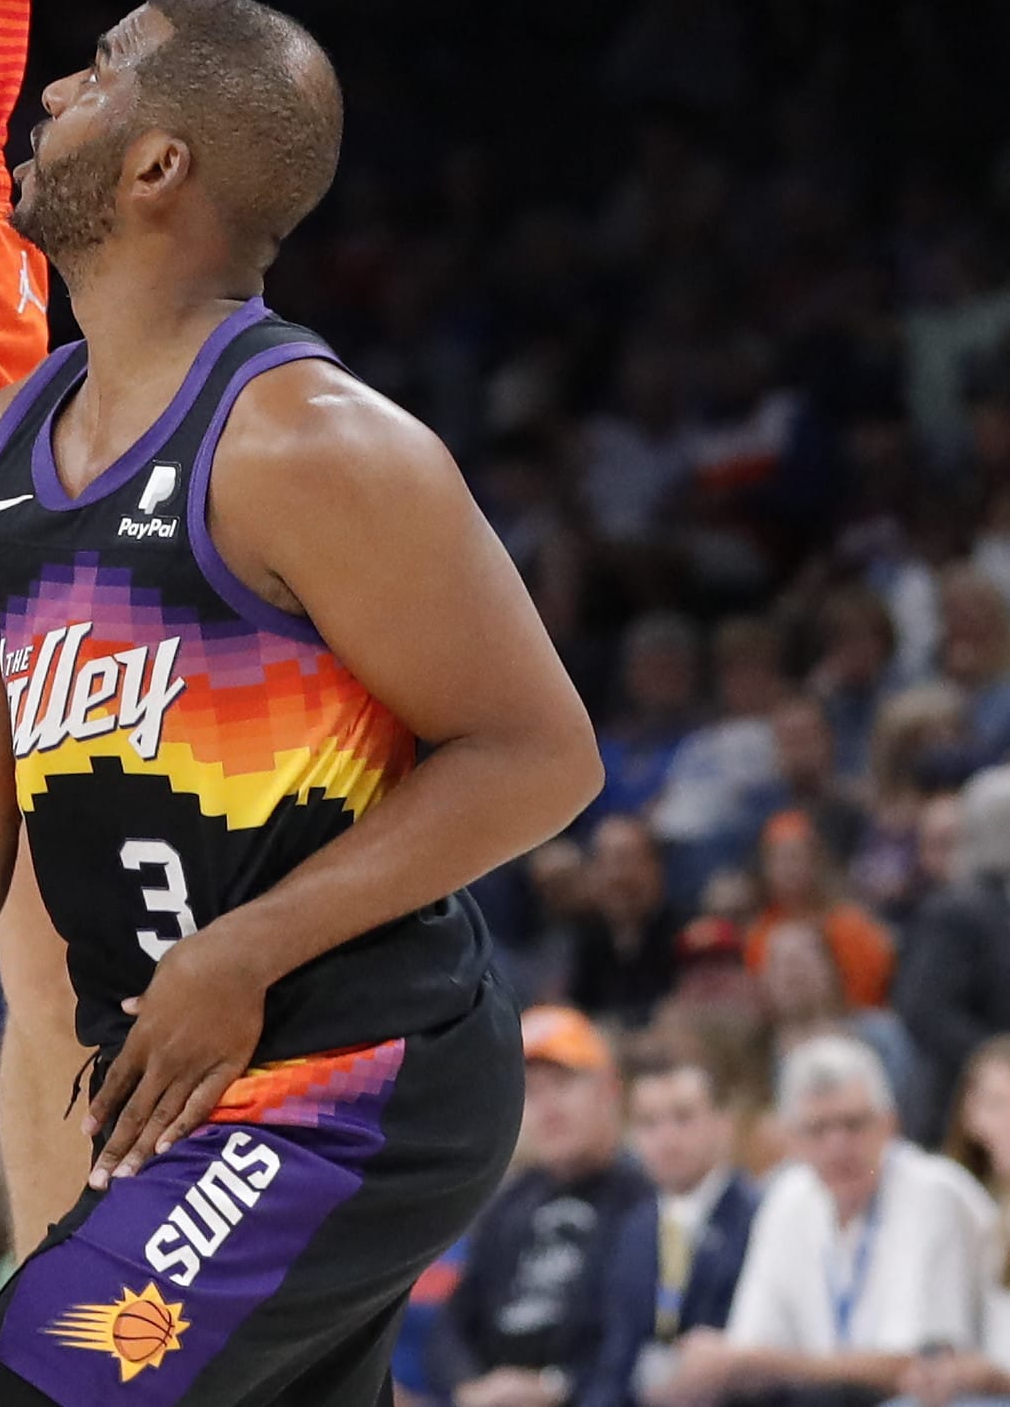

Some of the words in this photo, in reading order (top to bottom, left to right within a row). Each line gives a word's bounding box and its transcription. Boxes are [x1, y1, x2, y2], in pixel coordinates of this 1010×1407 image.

[117, 518, 177, 540] PayPal
[5, 645, 34, 676] THE
[119, 838, 198, 963] 3
[145, 1131, 281, 1286] SUNS
